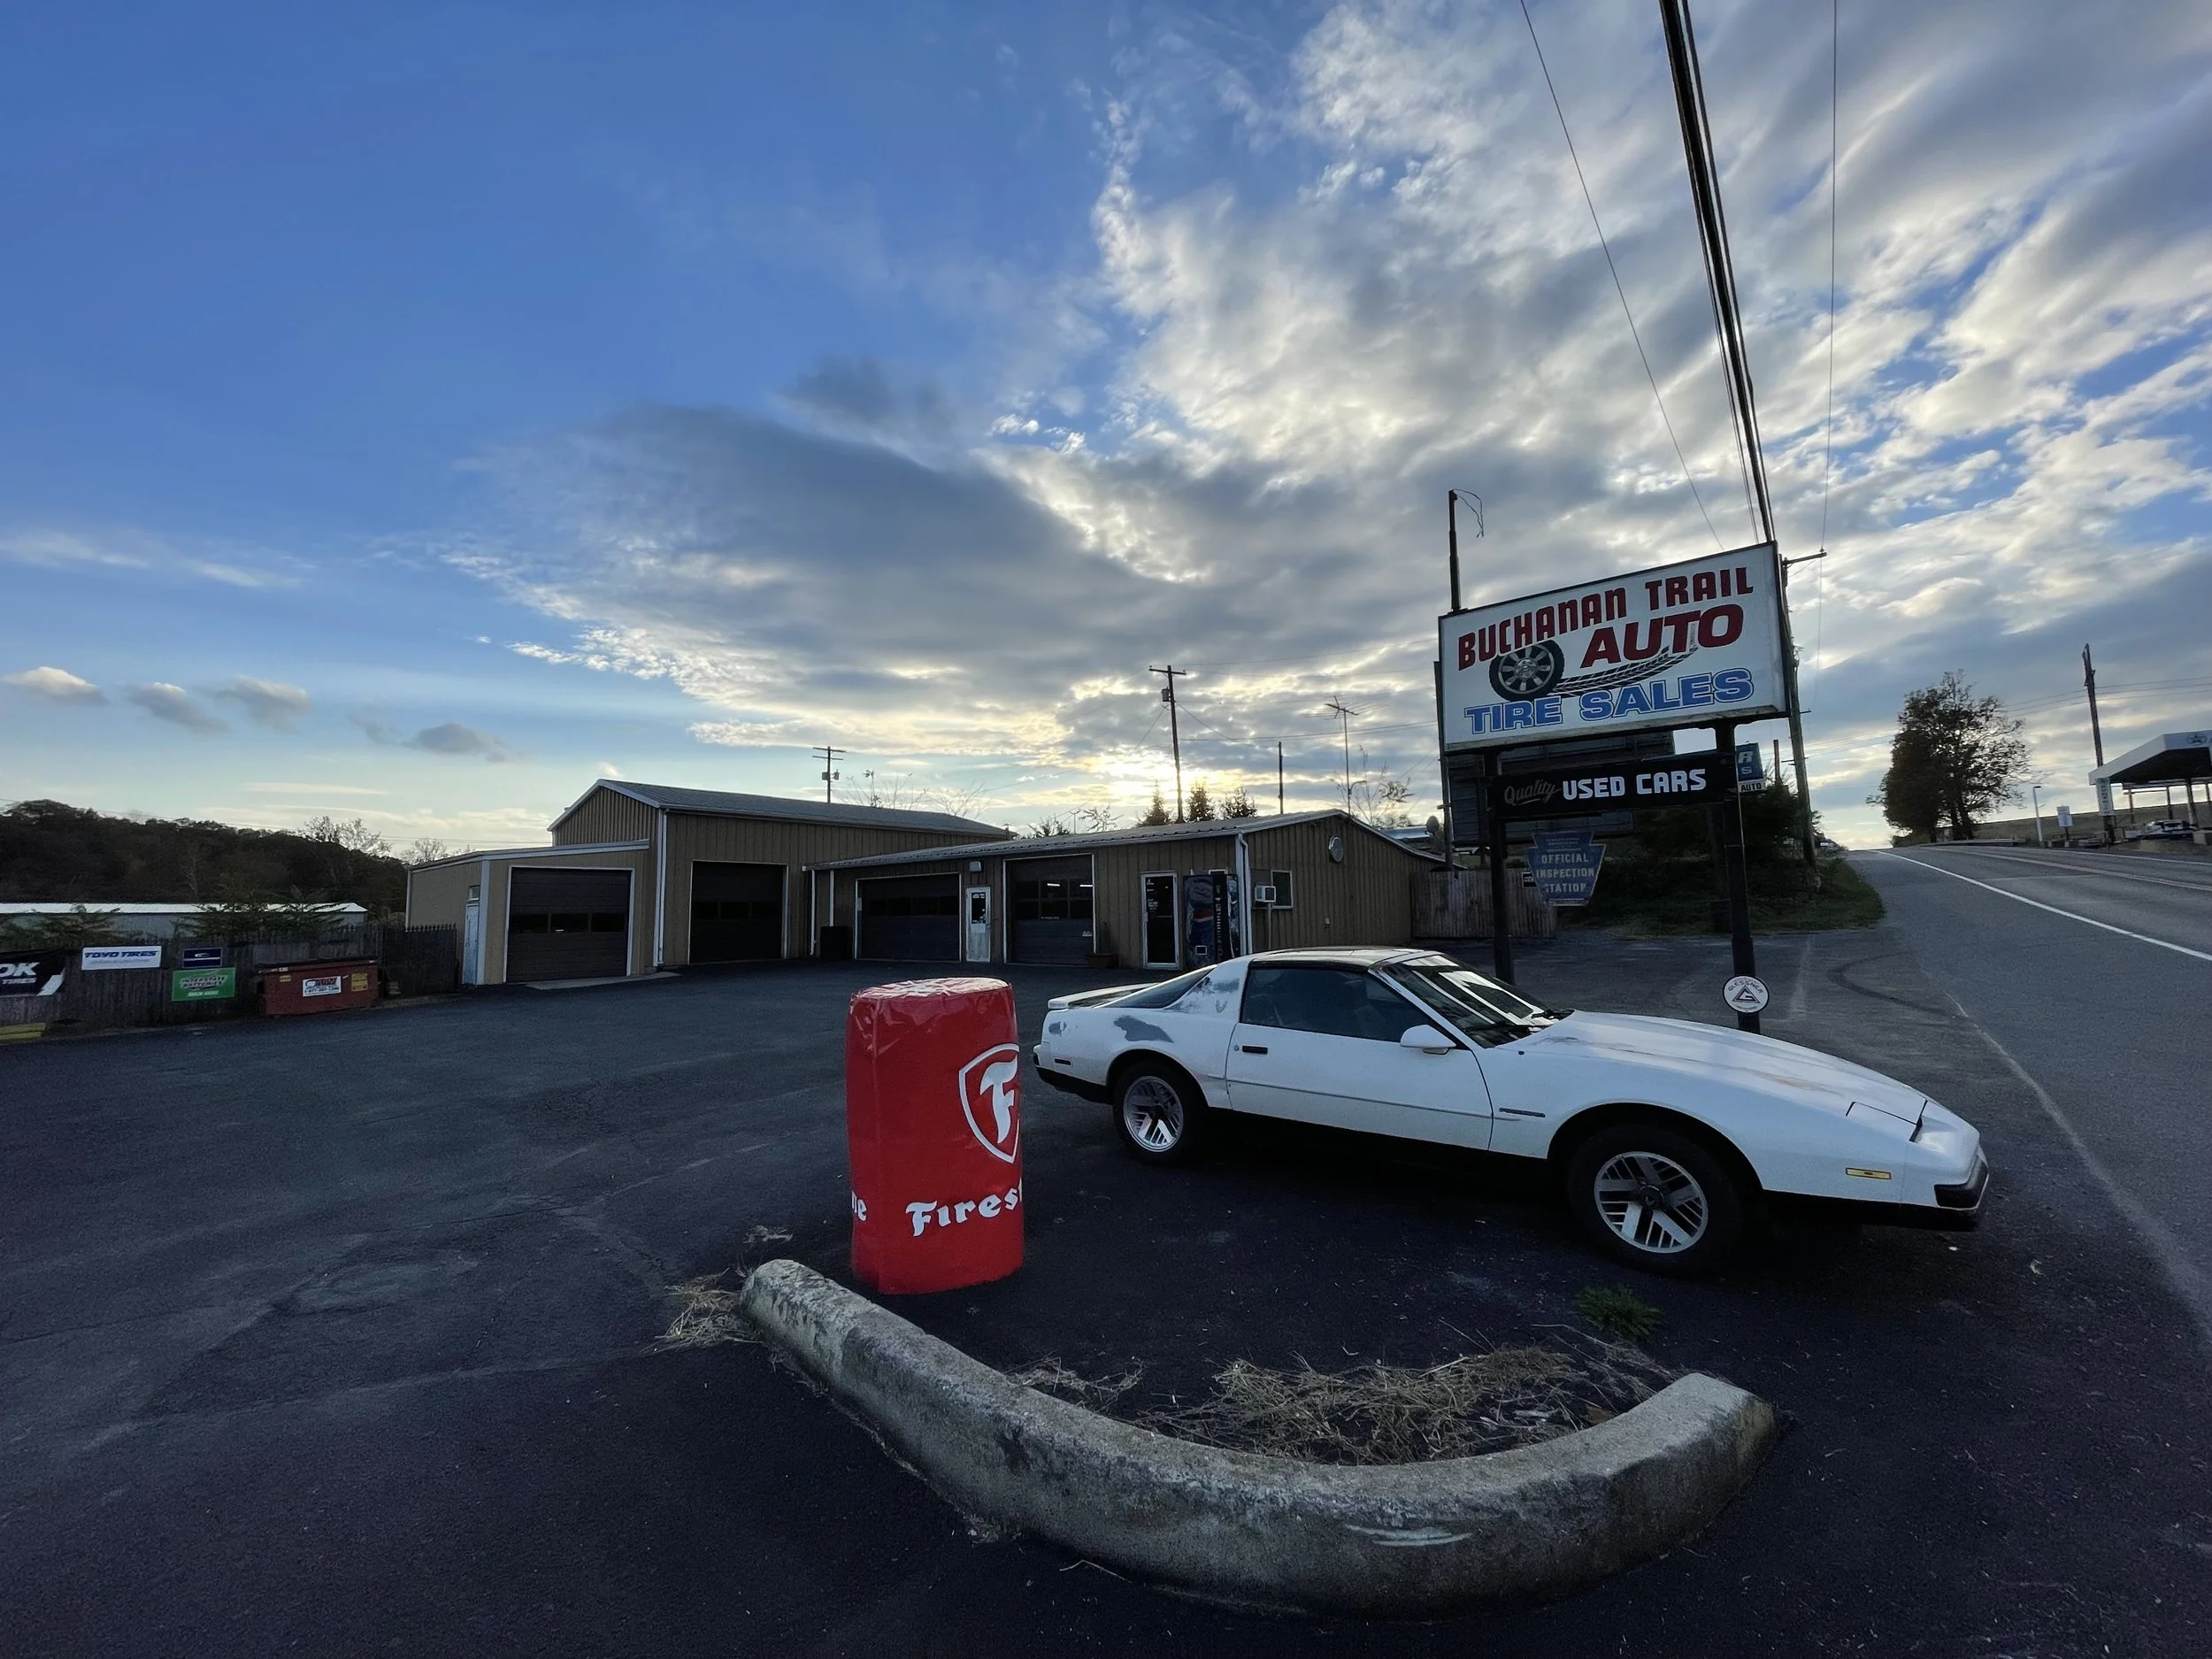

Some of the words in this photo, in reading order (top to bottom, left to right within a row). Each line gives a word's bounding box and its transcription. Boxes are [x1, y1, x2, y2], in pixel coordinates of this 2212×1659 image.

[1458, 587, 1627, 671] BUCHANAN
[1644, 566, 1754, 611] TRAIL
[1579, 603, 1745, 669] AUTO
[1464, 695, 1563, 735] TIRE
[1578, 668, 1754, 722] SALES
[1504, 779, 1562, 806] Quality
[1563, 776, 1625, 801] USED
[1636, 768, 1707, 795] CARS
[1740, 782, 1762, 792] AUTO
[1536, 868, 1594, 879] INSPECTION
[1541, 853, 1589, 864] OFFICIAL
[1728, 979, 1764, 994] GLESSNER
[905, 1177, 1023, 1237] Fires
